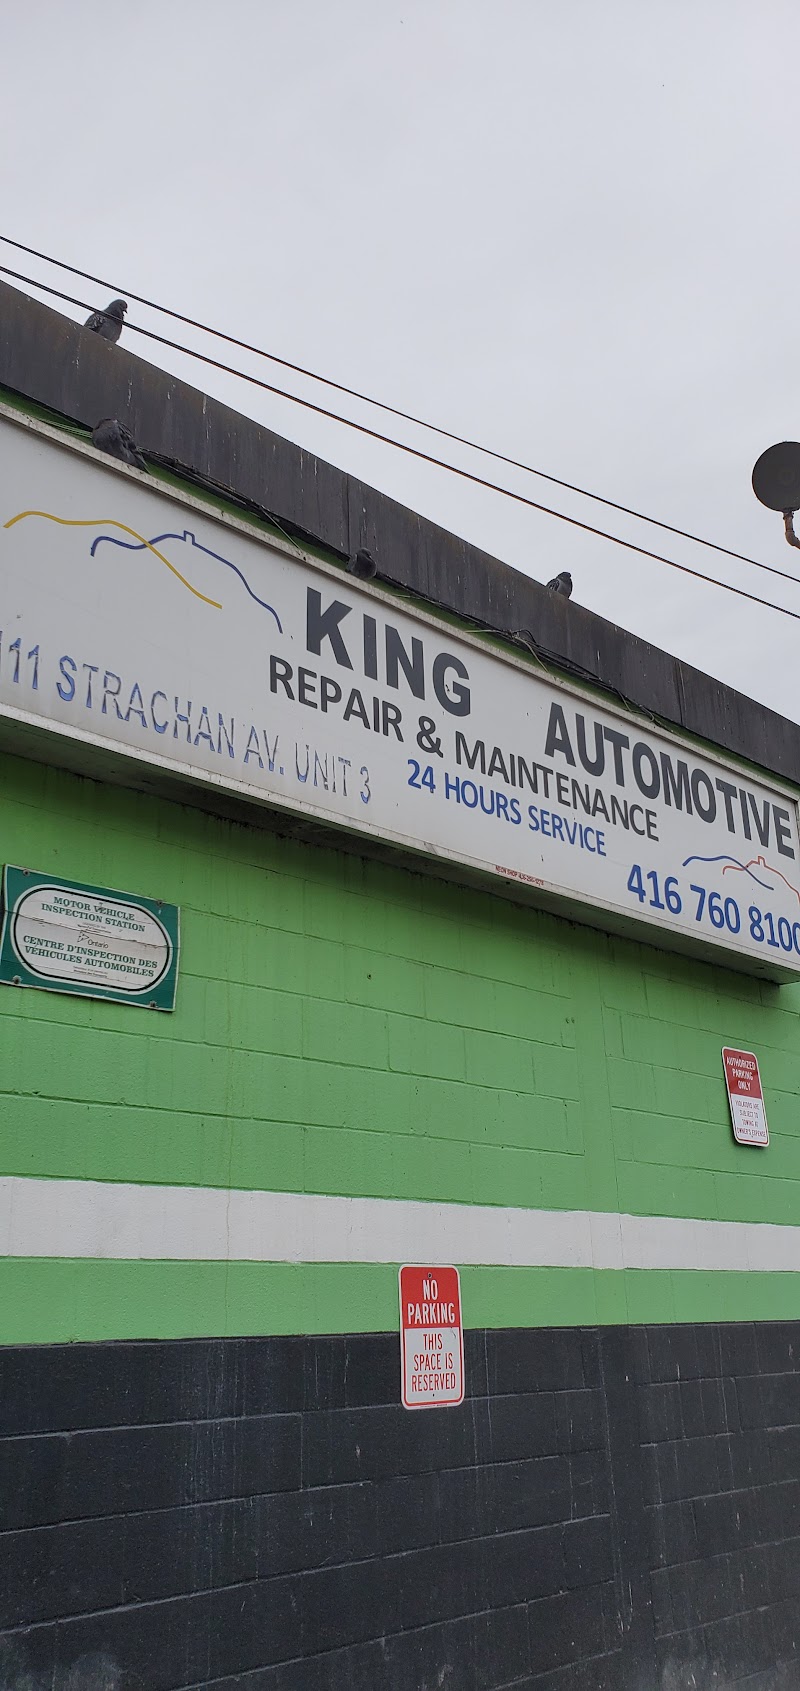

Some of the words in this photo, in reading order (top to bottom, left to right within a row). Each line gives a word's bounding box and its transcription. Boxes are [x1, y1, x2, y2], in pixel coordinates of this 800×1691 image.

[0, 631, 39, 690] 11
[56, 655, 234, 758] STRACHAN
[244, 726, 285, 775] AV.
[295, 742, 352, 796] UNIT
[359, 766, 372, 804] 3
[306, 586, 471, 717] KING
[544, 702, 795, 860] AUTOMOTIVE
[269, 654, 404, 742] REPAIR
[416, 715, 444, 758] &
[455, 731, 659, 843] MAINTENANCE
[407, 758, 436, 794] 24
[445, 772, 522, 825] HOURS
[528, 805, 607, 857] SERVICE
[53, 896, 91, 914] MOTOR
[94, 904, 135, 921] VEHICLE
[627, 864, 683, 914] 416
[690, 884, 741, 934] 760
[41, 903, 103, 923] INSPECTION
[105, 917, 146, 933] STATION
[23, 935, 65, 951] CENTRE
[67, 945, 136, 965] D'INSPECTION
[138, 958, 158, 969] DES
[87, 938, 109, 949] Ontario
[84, 957, 155, 978] AUTOMOBILES
[727, 1056, 755, 1070] AUTHORIZED
[732, 1068, 753, 1080] PARKING
[738, 1080, 751, 1090] ONLY
[422, 1279, 439, 1301] NO
[407, 1302, 456, 1325] PARKING
[423, 1333, 443, 1350] THIS
[413, 1352, 442, 1372] SPACE
[445, 1352, 454, 1370] IS
[411, 1372, 456, 1393] RESERVED
